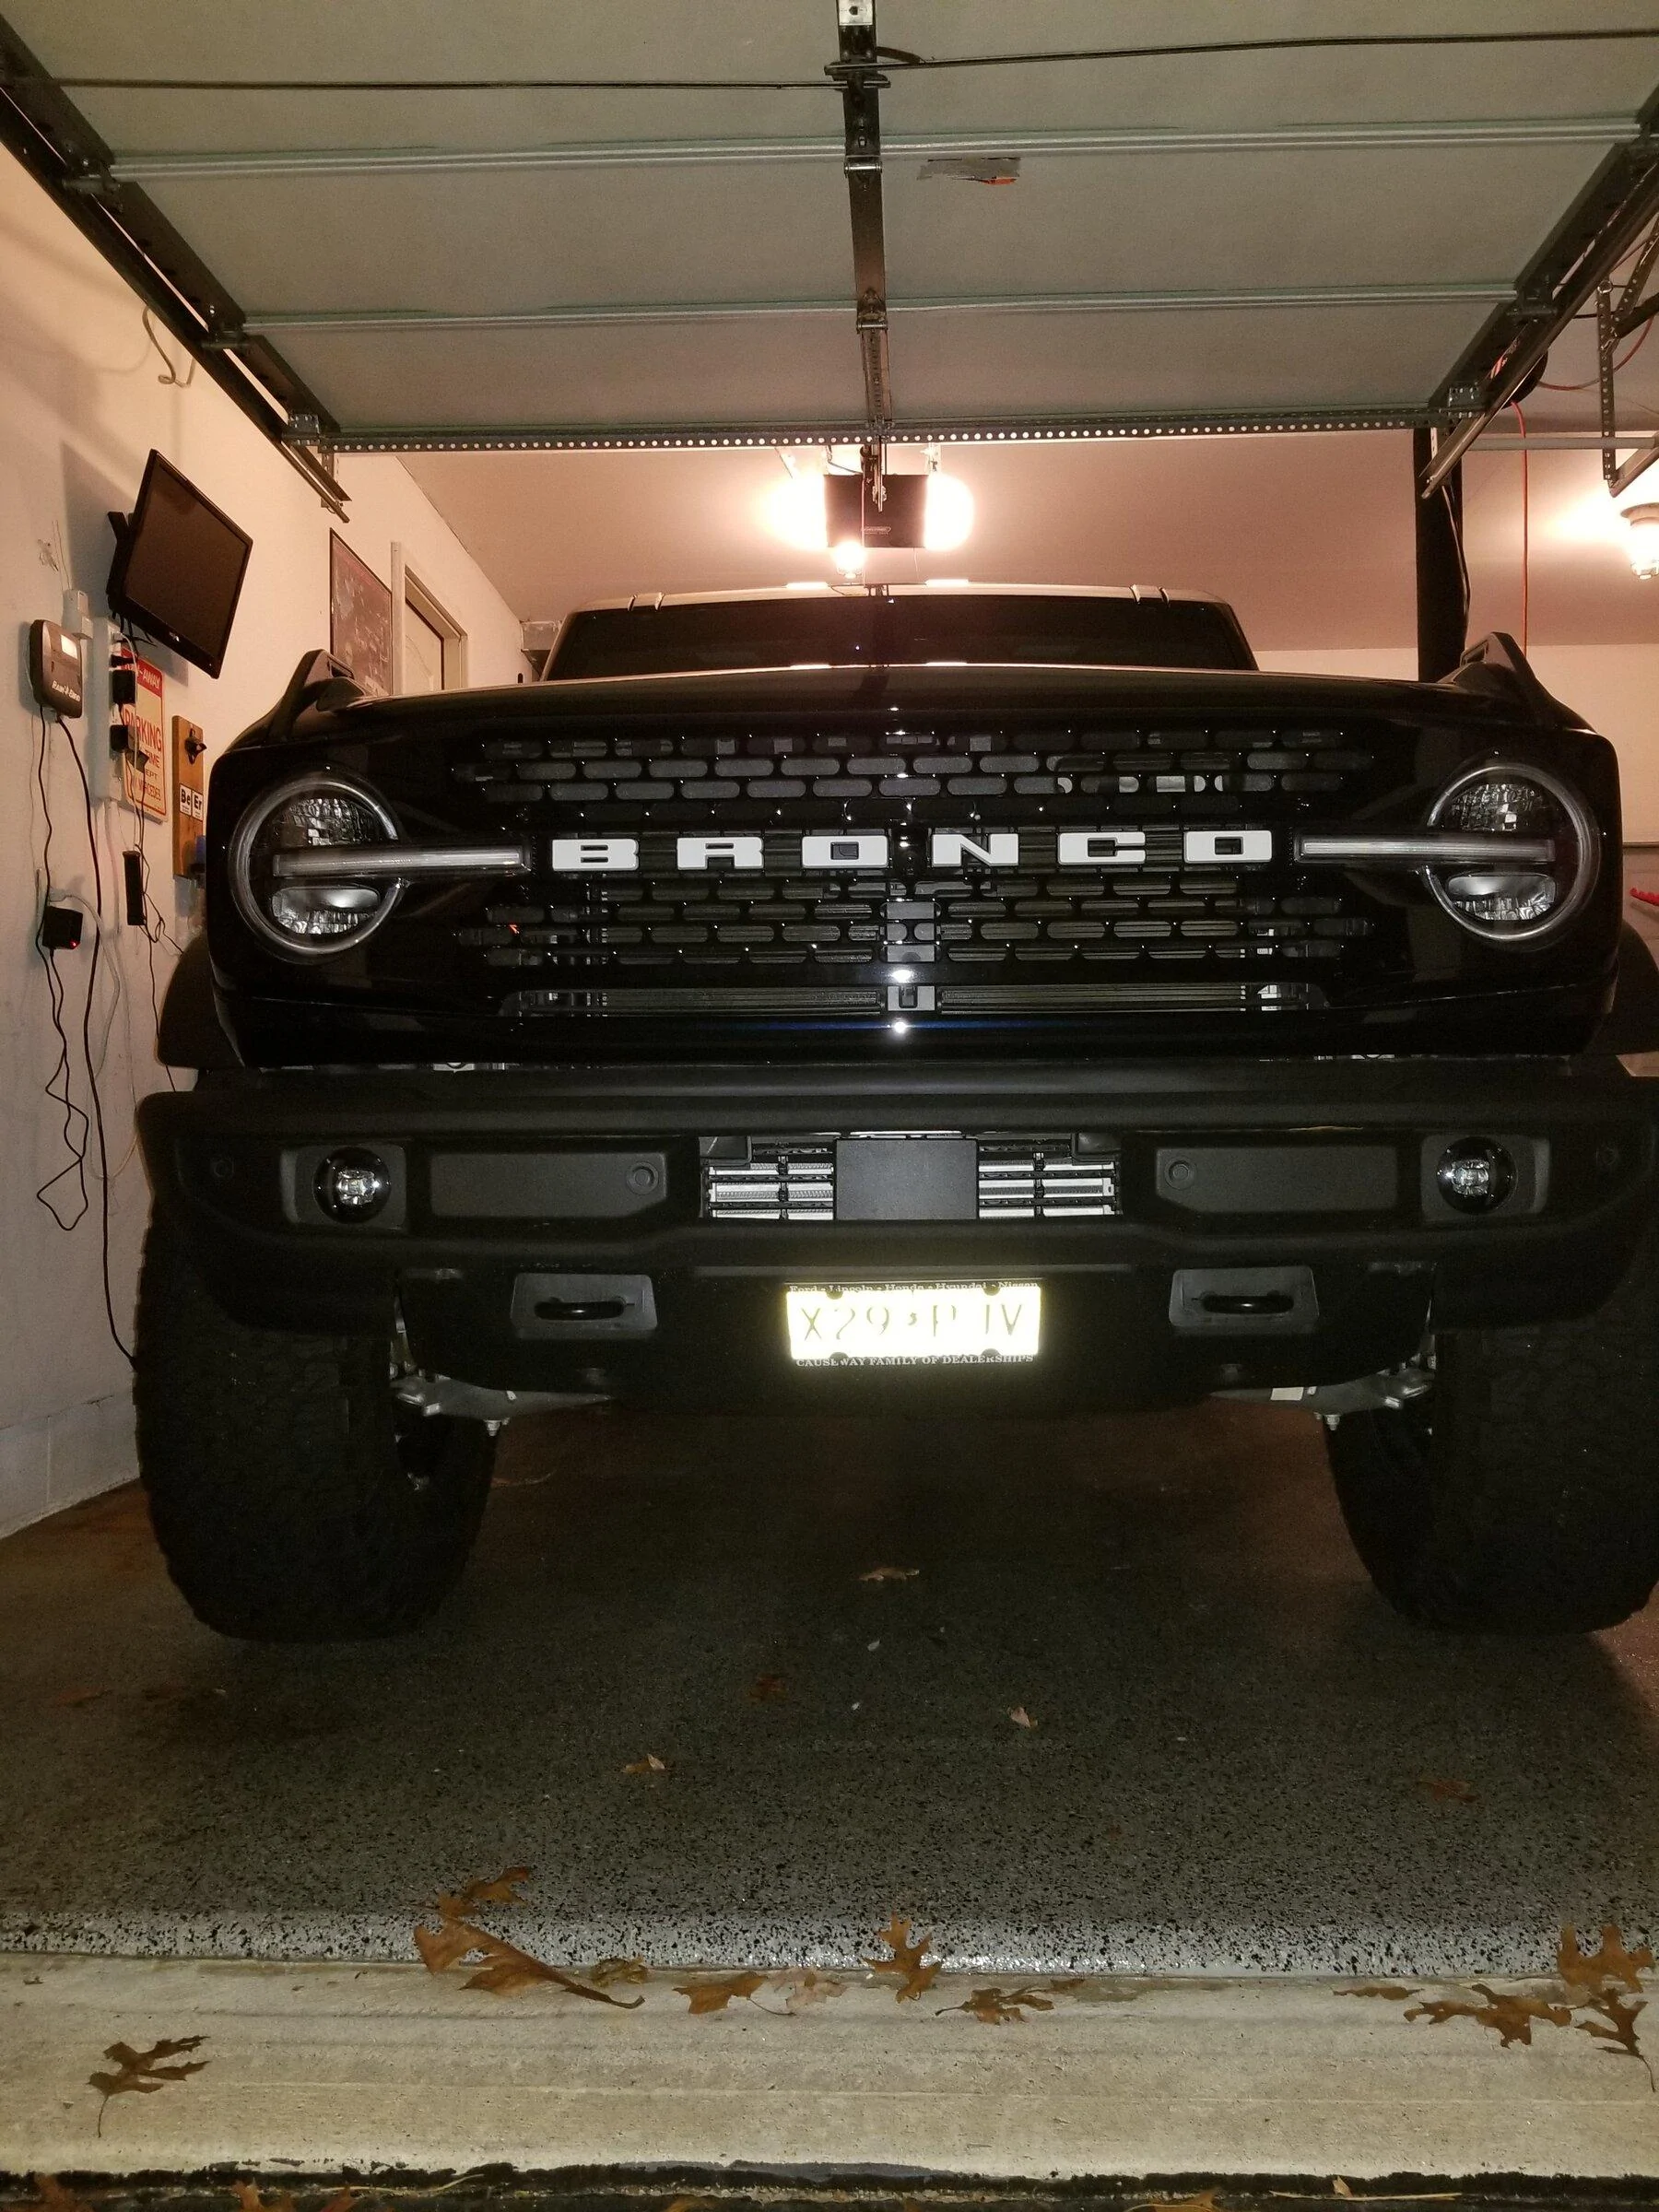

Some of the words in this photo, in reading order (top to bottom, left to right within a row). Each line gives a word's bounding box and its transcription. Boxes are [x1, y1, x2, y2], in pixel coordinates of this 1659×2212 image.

[552, 830, 1273, 871] BRONCO
[830, 1284, 874, 1292] Lincoln
[935, 1282, 986, 1290] Hyundai
[998, 1281, 1038, 1289] Nissan
[795, 1356, 867, 1367] CAUSEWAY
[869, 1355, 918, 1366] FAMILY
[922, 1355, 939, 1365] OF
[942, 1354, 1034, 1364] DEALERSHIPS
